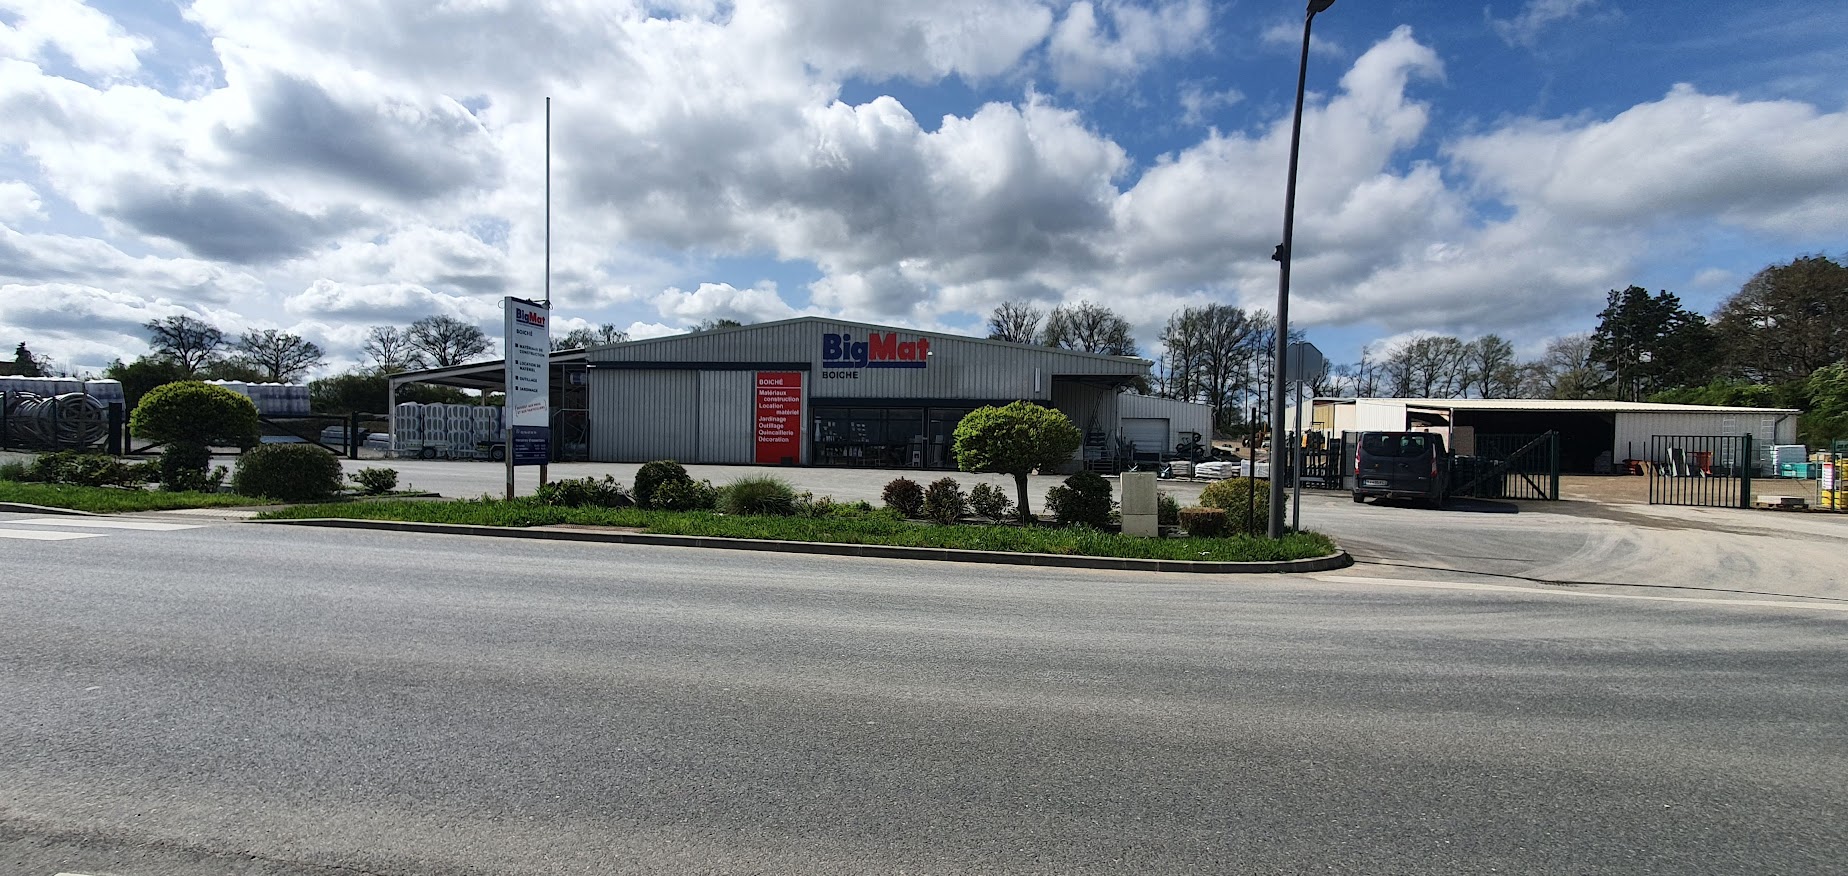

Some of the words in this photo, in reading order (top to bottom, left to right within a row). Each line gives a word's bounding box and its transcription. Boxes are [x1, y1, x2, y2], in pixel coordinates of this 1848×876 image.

[516, 308, 545, 325] BigMat
[823, 333, 929, 368] BigMat
[759, 378, 784, 386] BOICHÉ
[758, 422, 784, 430] Outillage
[758, 429, 794, 437] Quincaillerie
